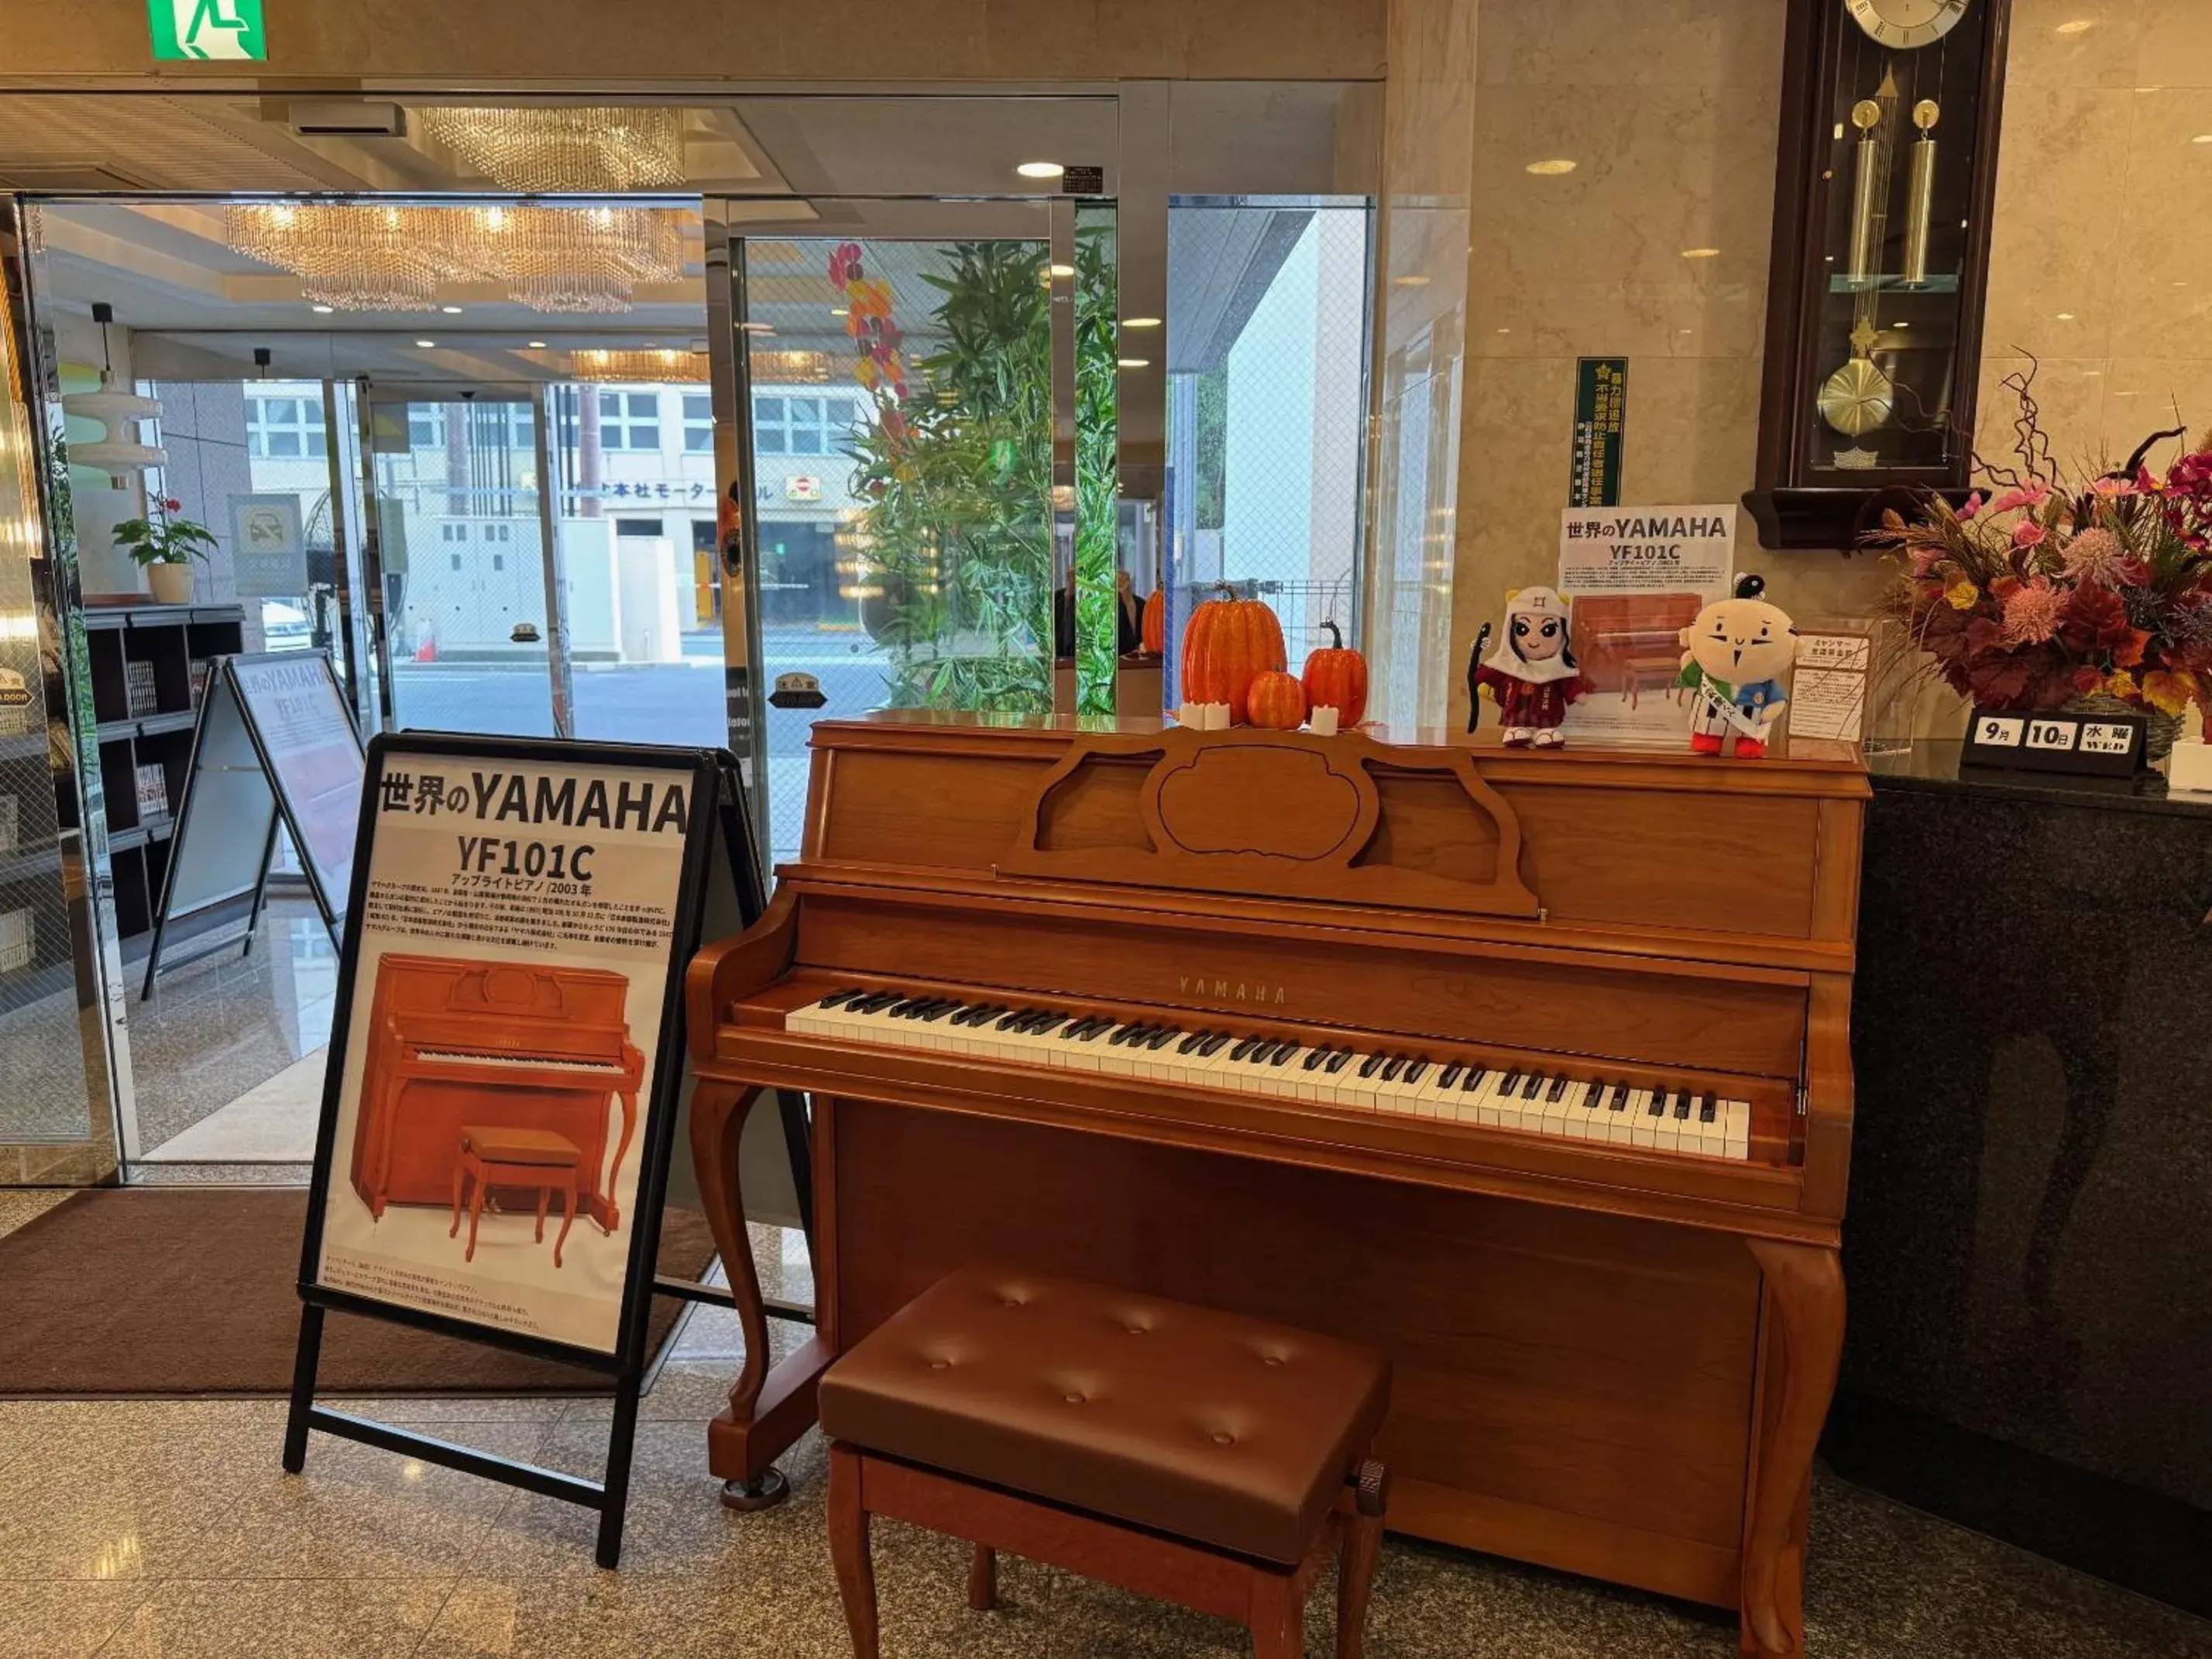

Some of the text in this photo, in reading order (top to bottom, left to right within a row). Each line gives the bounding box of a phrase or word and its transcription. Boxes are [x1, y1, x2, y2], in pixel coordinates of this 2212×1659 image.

[1566, 517, 1727, 539] 世界のYAMAHA
[1609, 544, 1681, 559] YF101C
[1985, 721, 2010, 741] 9月
[2033, 725, 2069, 746] 10日
[2086, 740, 2124, 750] WED
[380, 771, 689, 834] 世界のYAMAHA
[458, 835, 596, 881] YF101C
[1180, 975, 1285, 1005] YAMAHA
